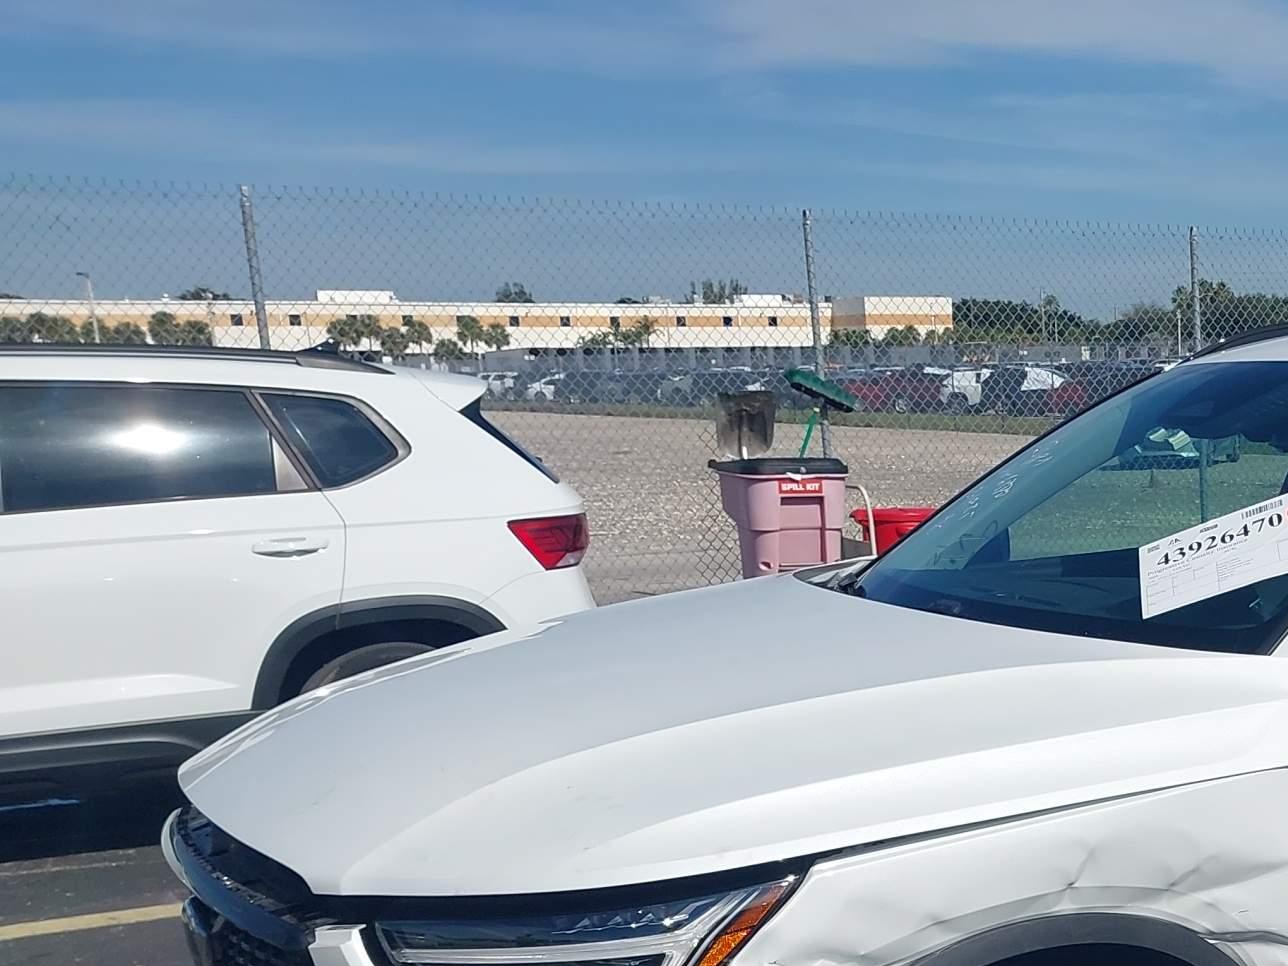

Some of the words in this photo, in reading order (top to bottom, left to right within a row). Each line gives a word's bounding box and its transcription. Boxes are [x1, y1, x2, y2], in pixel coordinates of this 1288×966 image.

[781, 482, 805, 491] SPILL
[806, 482, 820, 491] KIT
[1157, 513, 1283, 567] 43926470
